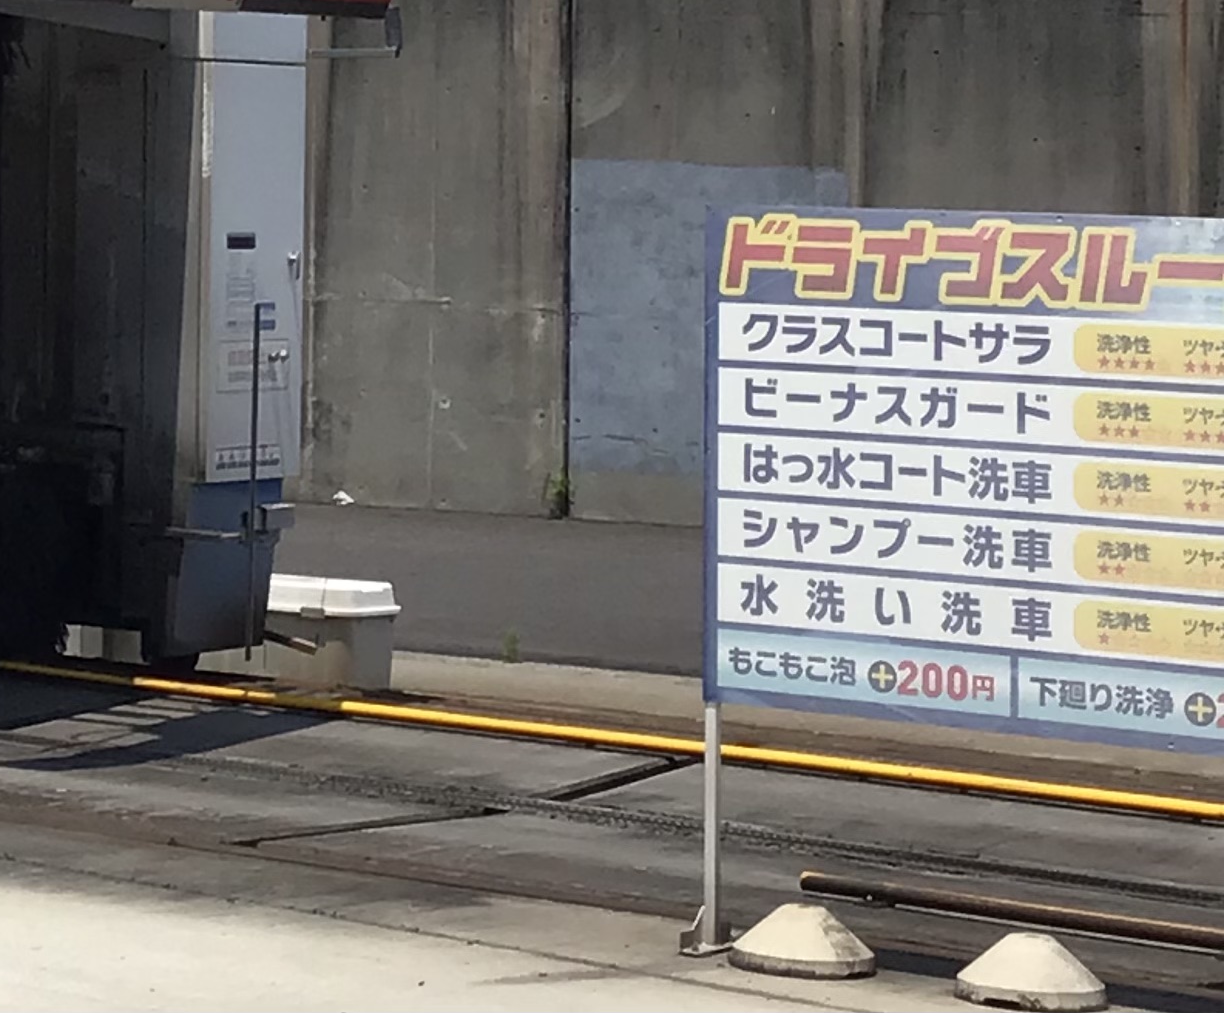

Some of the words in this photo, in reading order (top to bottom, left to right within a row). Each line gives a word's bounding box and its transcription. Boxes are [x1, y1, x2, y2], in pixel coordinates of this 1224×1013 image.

[744, 377, 1051, 434] ビーナスガード
[743, 443, 1053, 504] はっ水コート洗車
[742, 509, 1053, 573] シャンプー洗車
[740, 574, 1053, 642] 水洗い洗車
[728, 646, 857, 687] もこもこ泡
[1029, 676, 1174, 720] 下廻り洗浄
